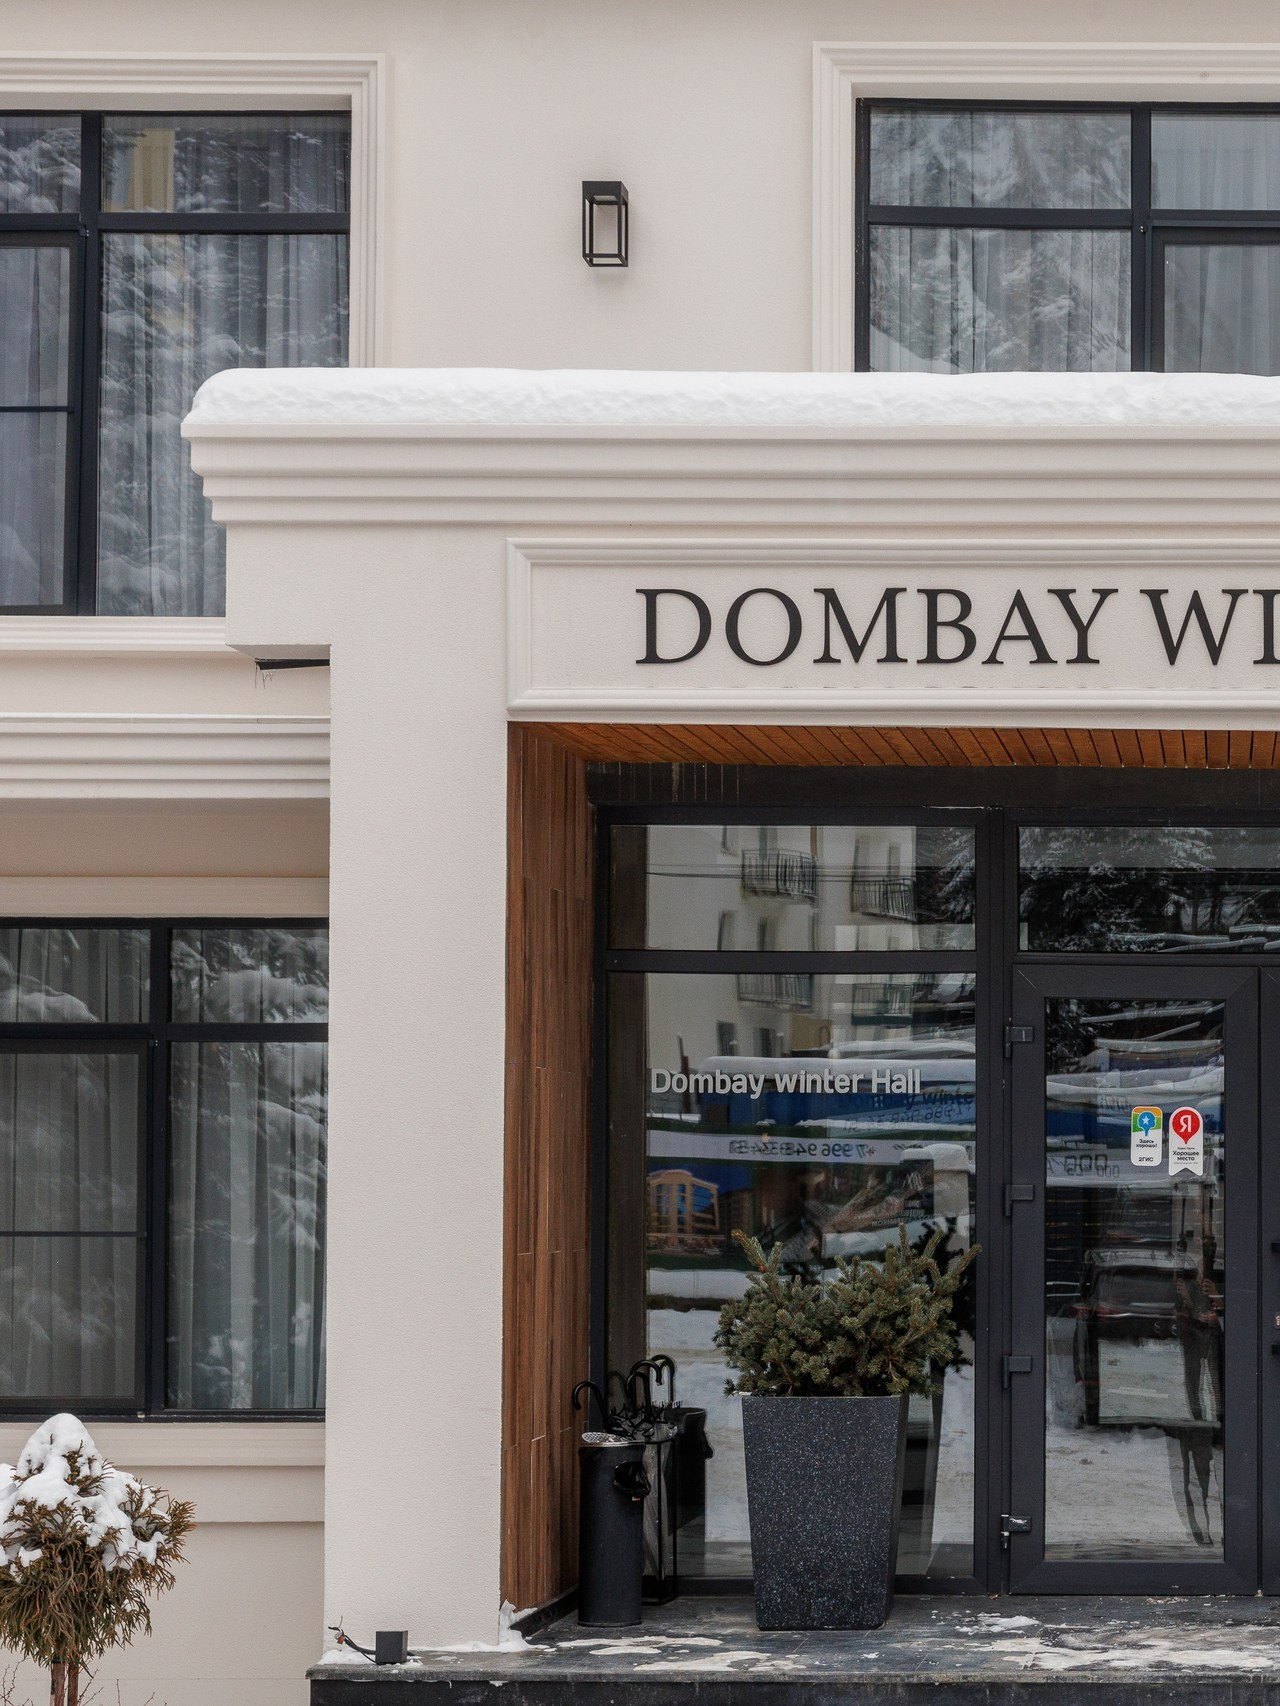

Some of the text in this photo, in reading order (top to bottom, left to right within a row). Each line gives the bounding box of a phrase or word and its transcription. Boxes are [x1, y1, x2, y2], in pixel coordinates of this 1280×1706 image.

[635, 587, 1119, 666] DOMBAY
[651, 1068, 922, 1100] Dombay winter Hall
